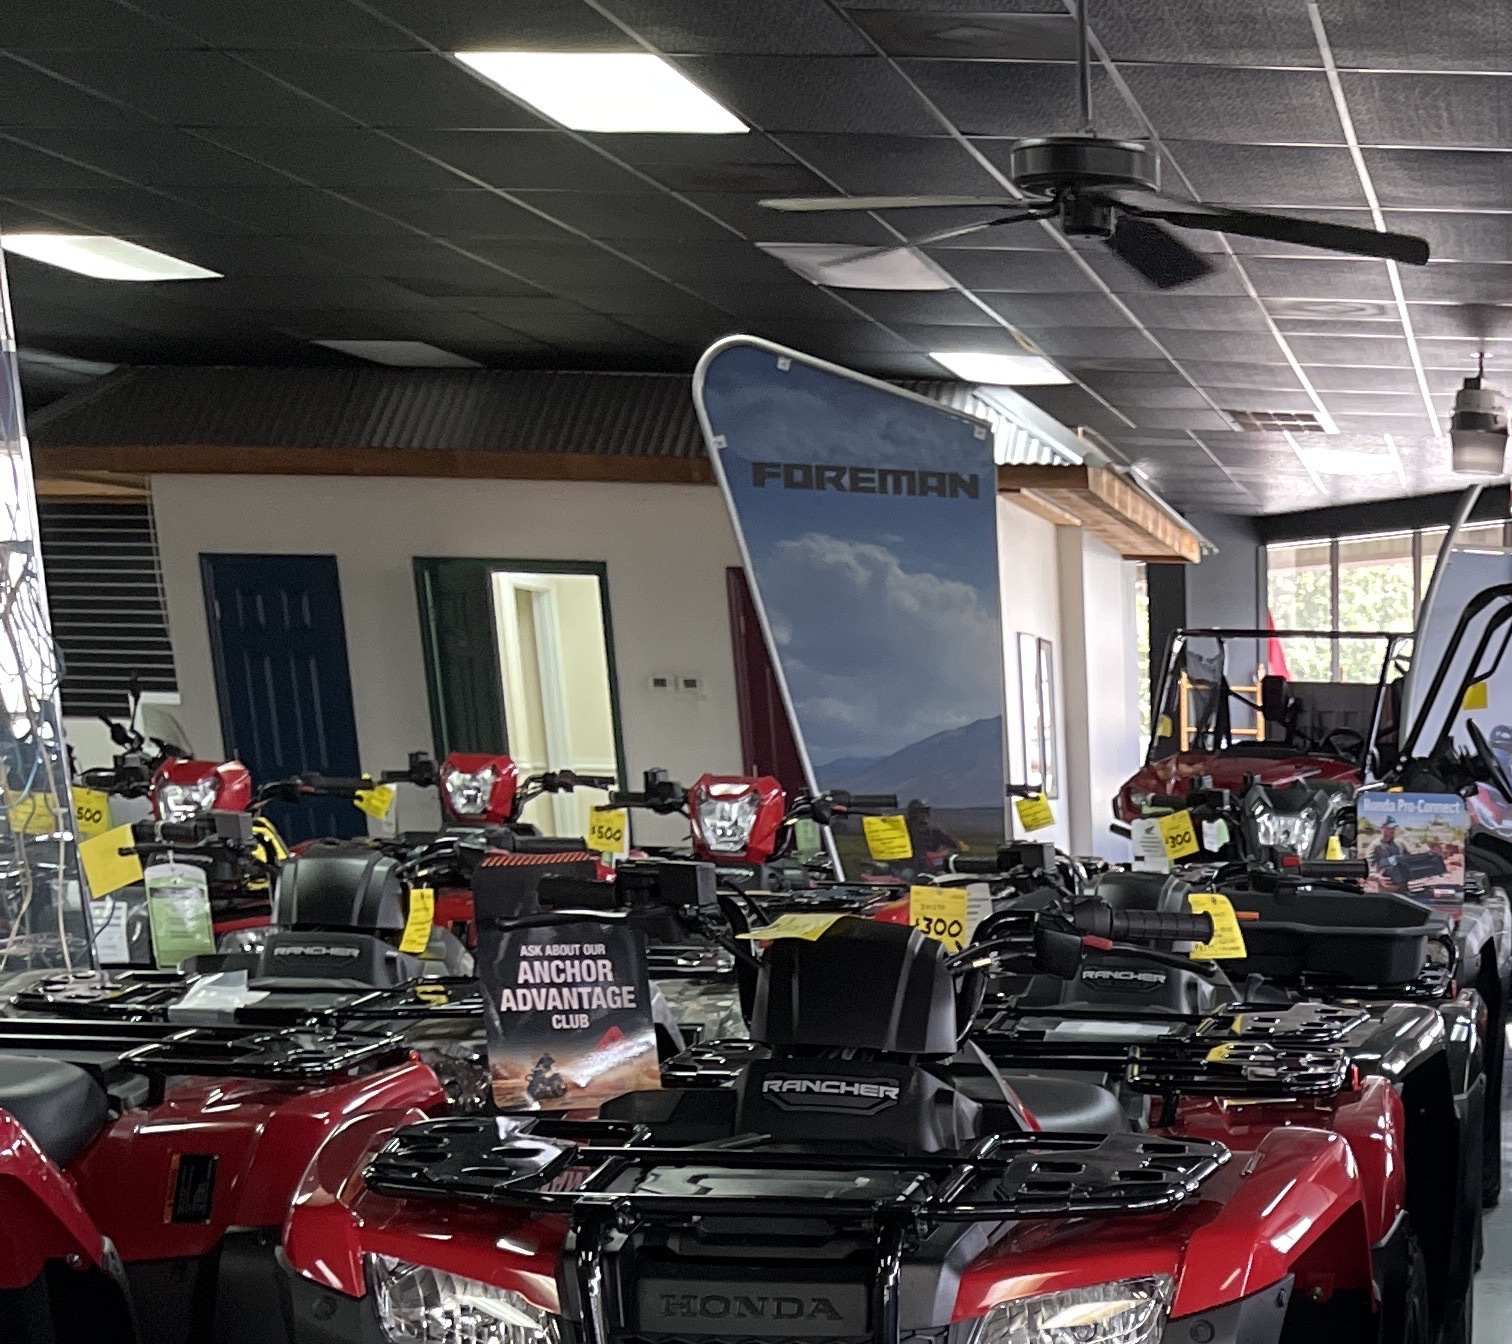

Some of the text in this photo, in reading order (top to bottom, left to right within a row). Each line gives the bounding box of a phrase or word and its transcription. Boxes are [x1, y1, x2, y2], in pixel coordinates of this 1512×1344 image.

[752, 462, 979, 499] FOREMAN
[1363, 798, 1460, 813] Honda Pro-Connect
[520, 943, 606, 957] ASK ABOUT OUR
[517, 959, 614, 984] ANCHOR
[500, 985, 637, 1012] ADVANTAGE
[551, 1014, 590, 1029] CLUB
[762, 1080, 900, 1100] RANCHER
[659, 1293, 844, 1321] HONDA
